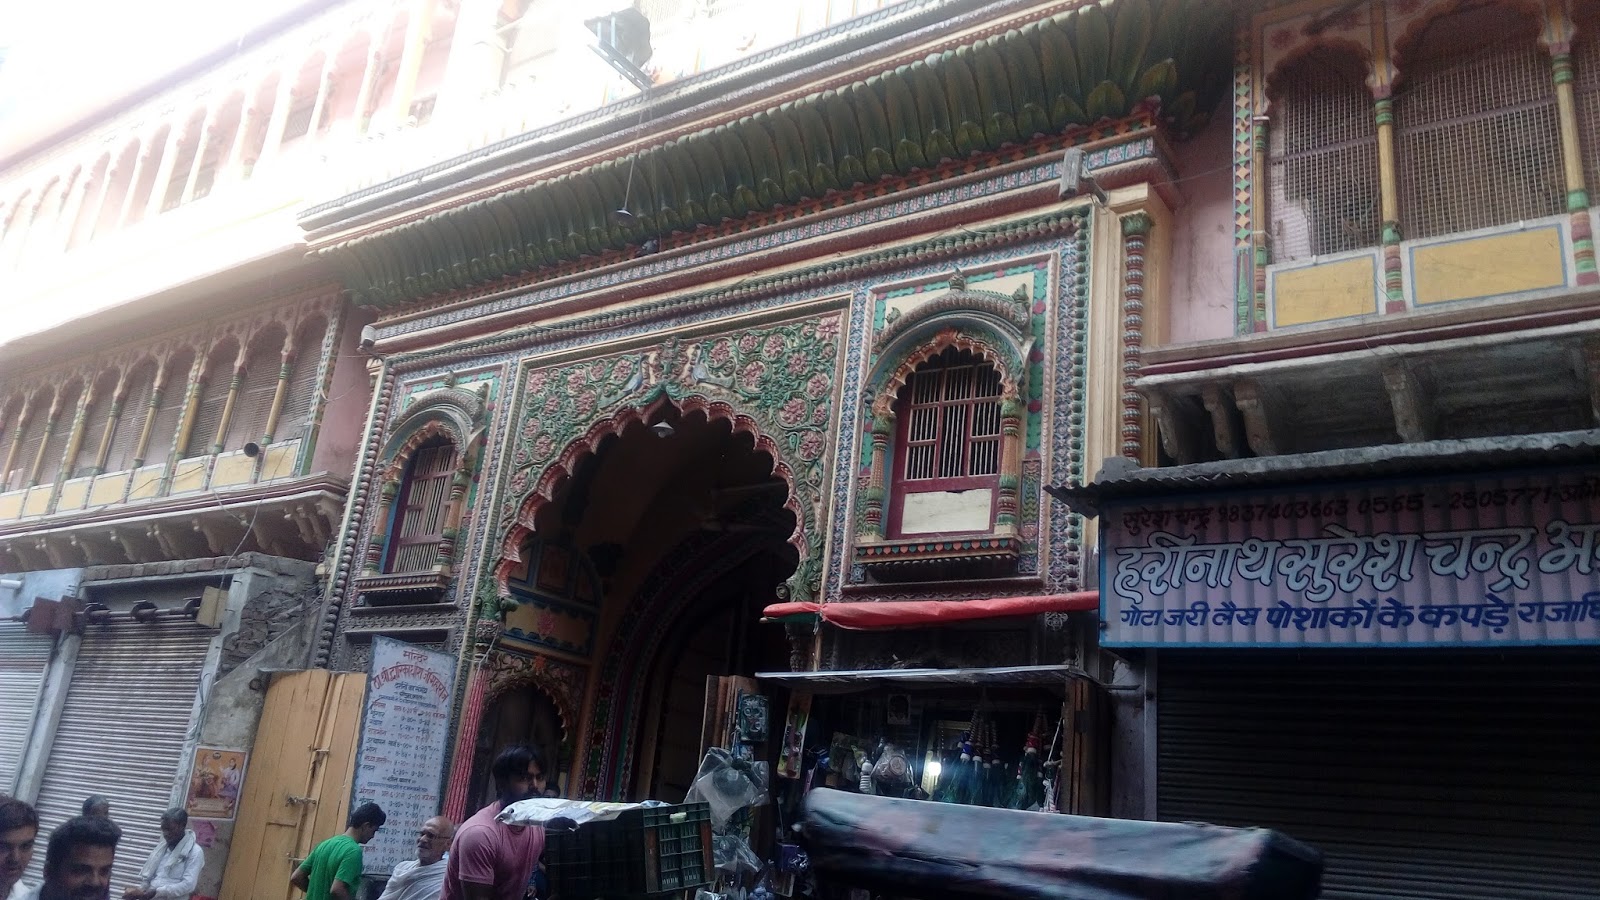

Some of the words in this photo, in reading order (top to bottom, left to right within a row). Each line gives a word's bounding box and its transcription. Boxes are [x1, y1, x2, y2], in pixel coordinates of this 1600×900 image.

[1122, 505, 1171, 536] सुरेश
[1175, 506, 1214, 530] चन्द्र
[1357, 493, 1425, 515] 0565
[1278, 522, 1421, 603] सुरेश
[1423, 526, 1540, 592] चन्द्र
[1120, 604, 1163, 626] गोटा
[1164, 600, 1210, 626] जरी
[1212, 600, 1262, 626] लैस
[1376, 597, 1415, 628] के
[1418, 592, 1516, 634] कपड़े
